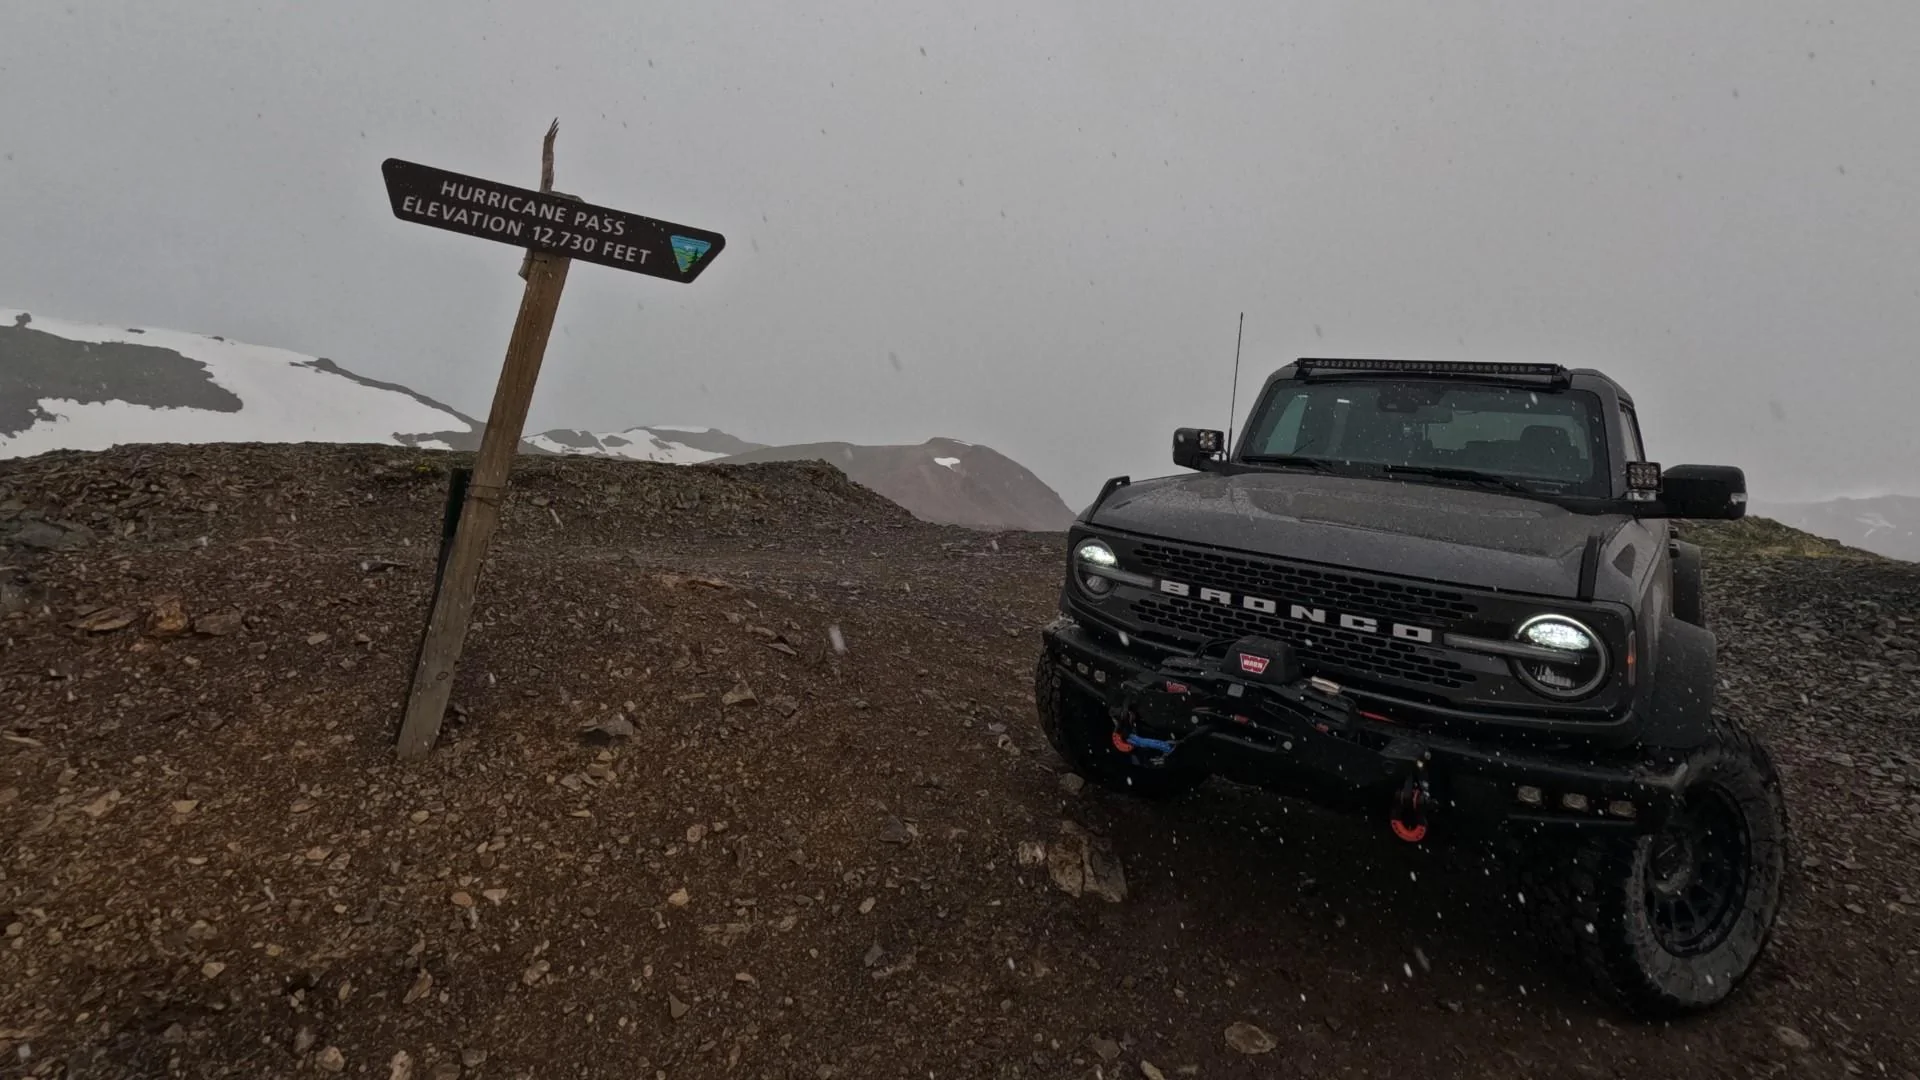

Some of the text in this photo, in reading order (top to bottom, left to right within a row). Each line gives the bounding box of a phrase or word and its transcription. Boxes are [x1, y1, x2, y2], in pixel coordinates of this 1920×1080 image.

[402, 195, 652, 265] ELEVATION 12,730 FEET
[440, 180, 626, 236] HURRICANE PASS
[1160, 579, 1433, 643] BRONCO
